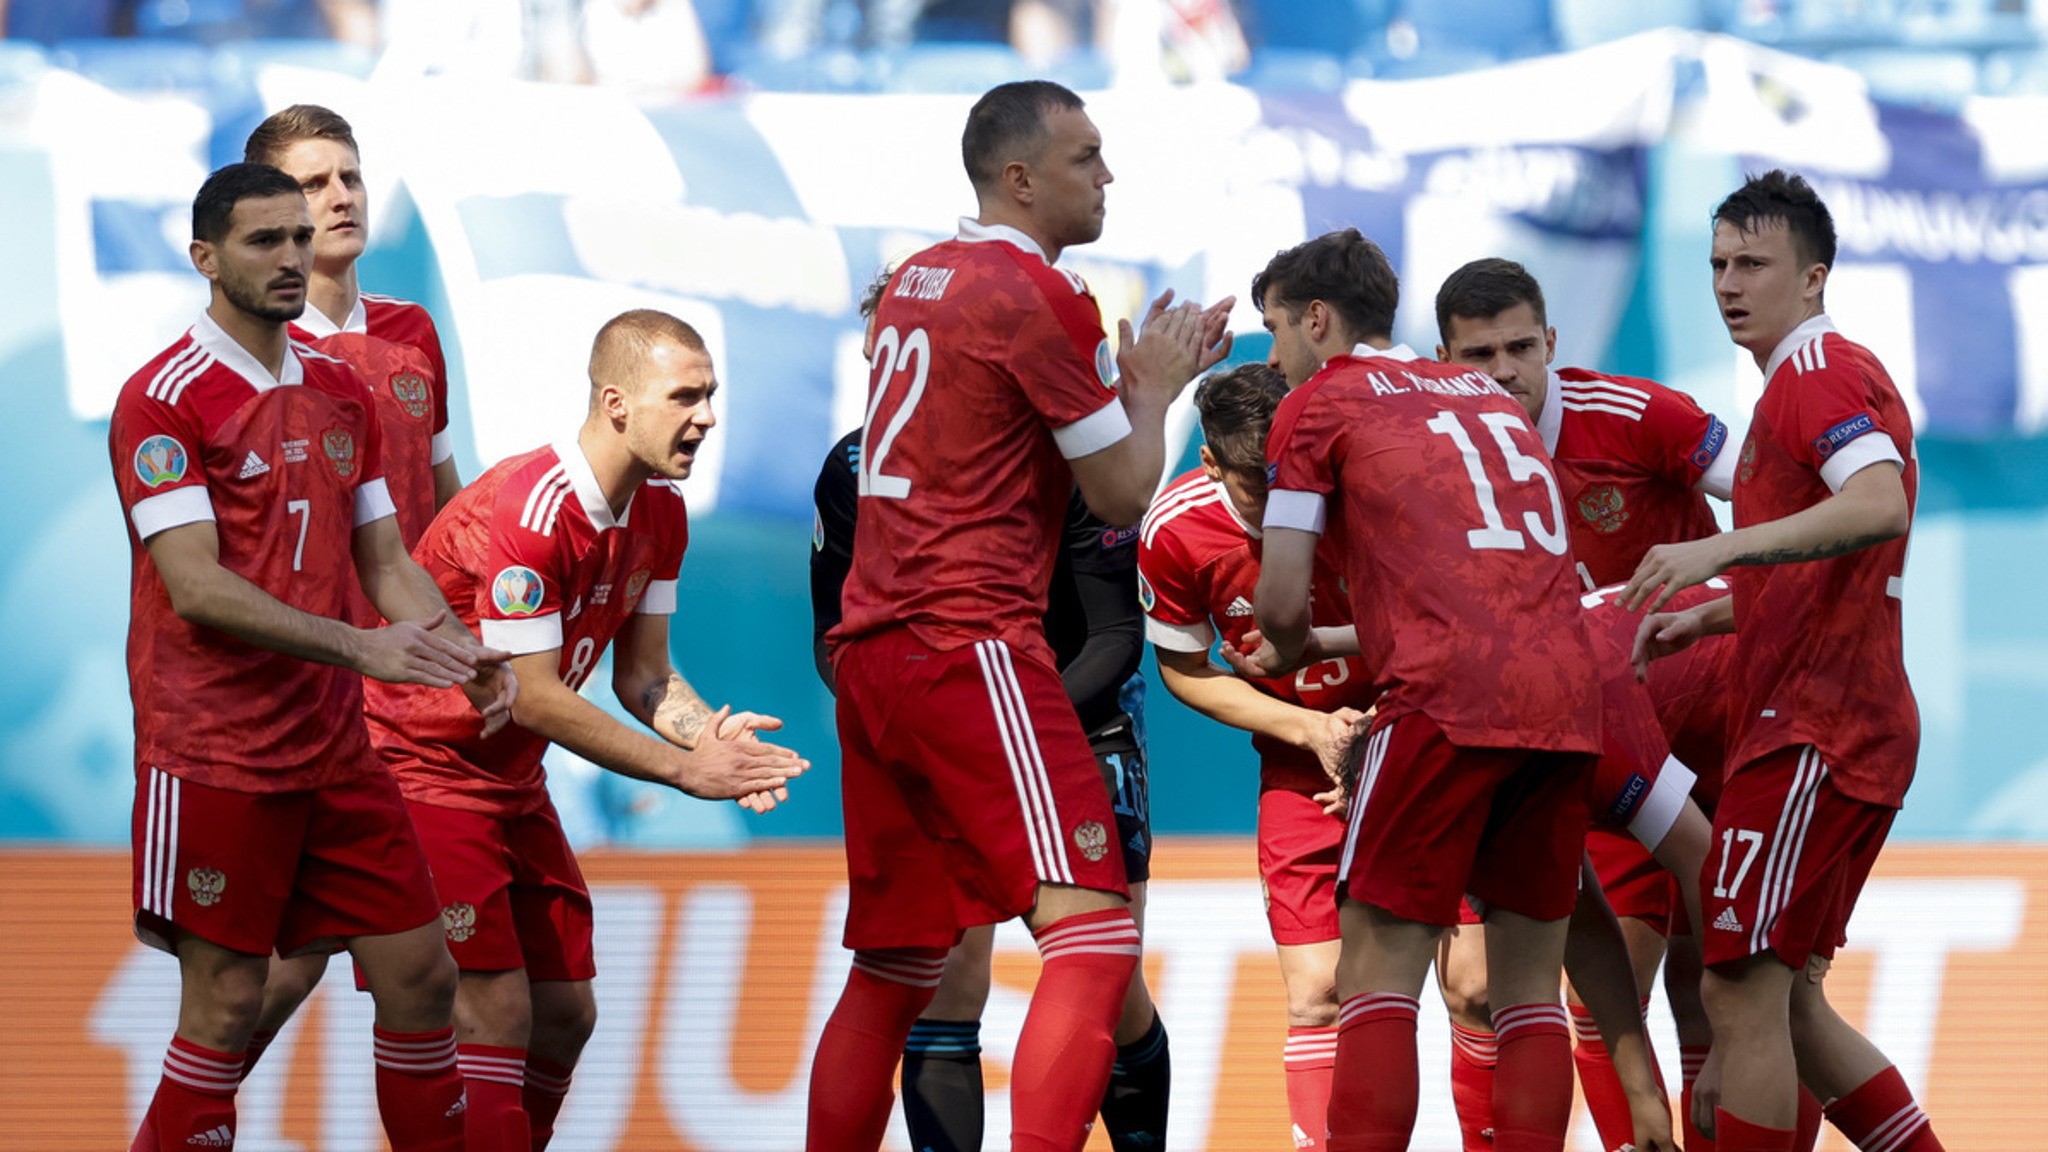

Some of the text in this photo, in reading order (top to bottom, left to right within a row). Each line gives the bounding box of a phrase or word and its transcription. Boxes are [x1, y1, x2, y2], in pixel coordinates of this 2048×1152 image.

[893, 264, 957, 301] DZYUBA
[858, 325, 931, 499] 22
[1366, 371, 1412, 397] AL.
[1830, 416, 1872, 445] RESPECT
[1426, 410, 1568, 556] 15
[287, 499, 310, 572] 7
[563, 637, 594, 690] 8
[1713, 827, 1764, 900] 17
